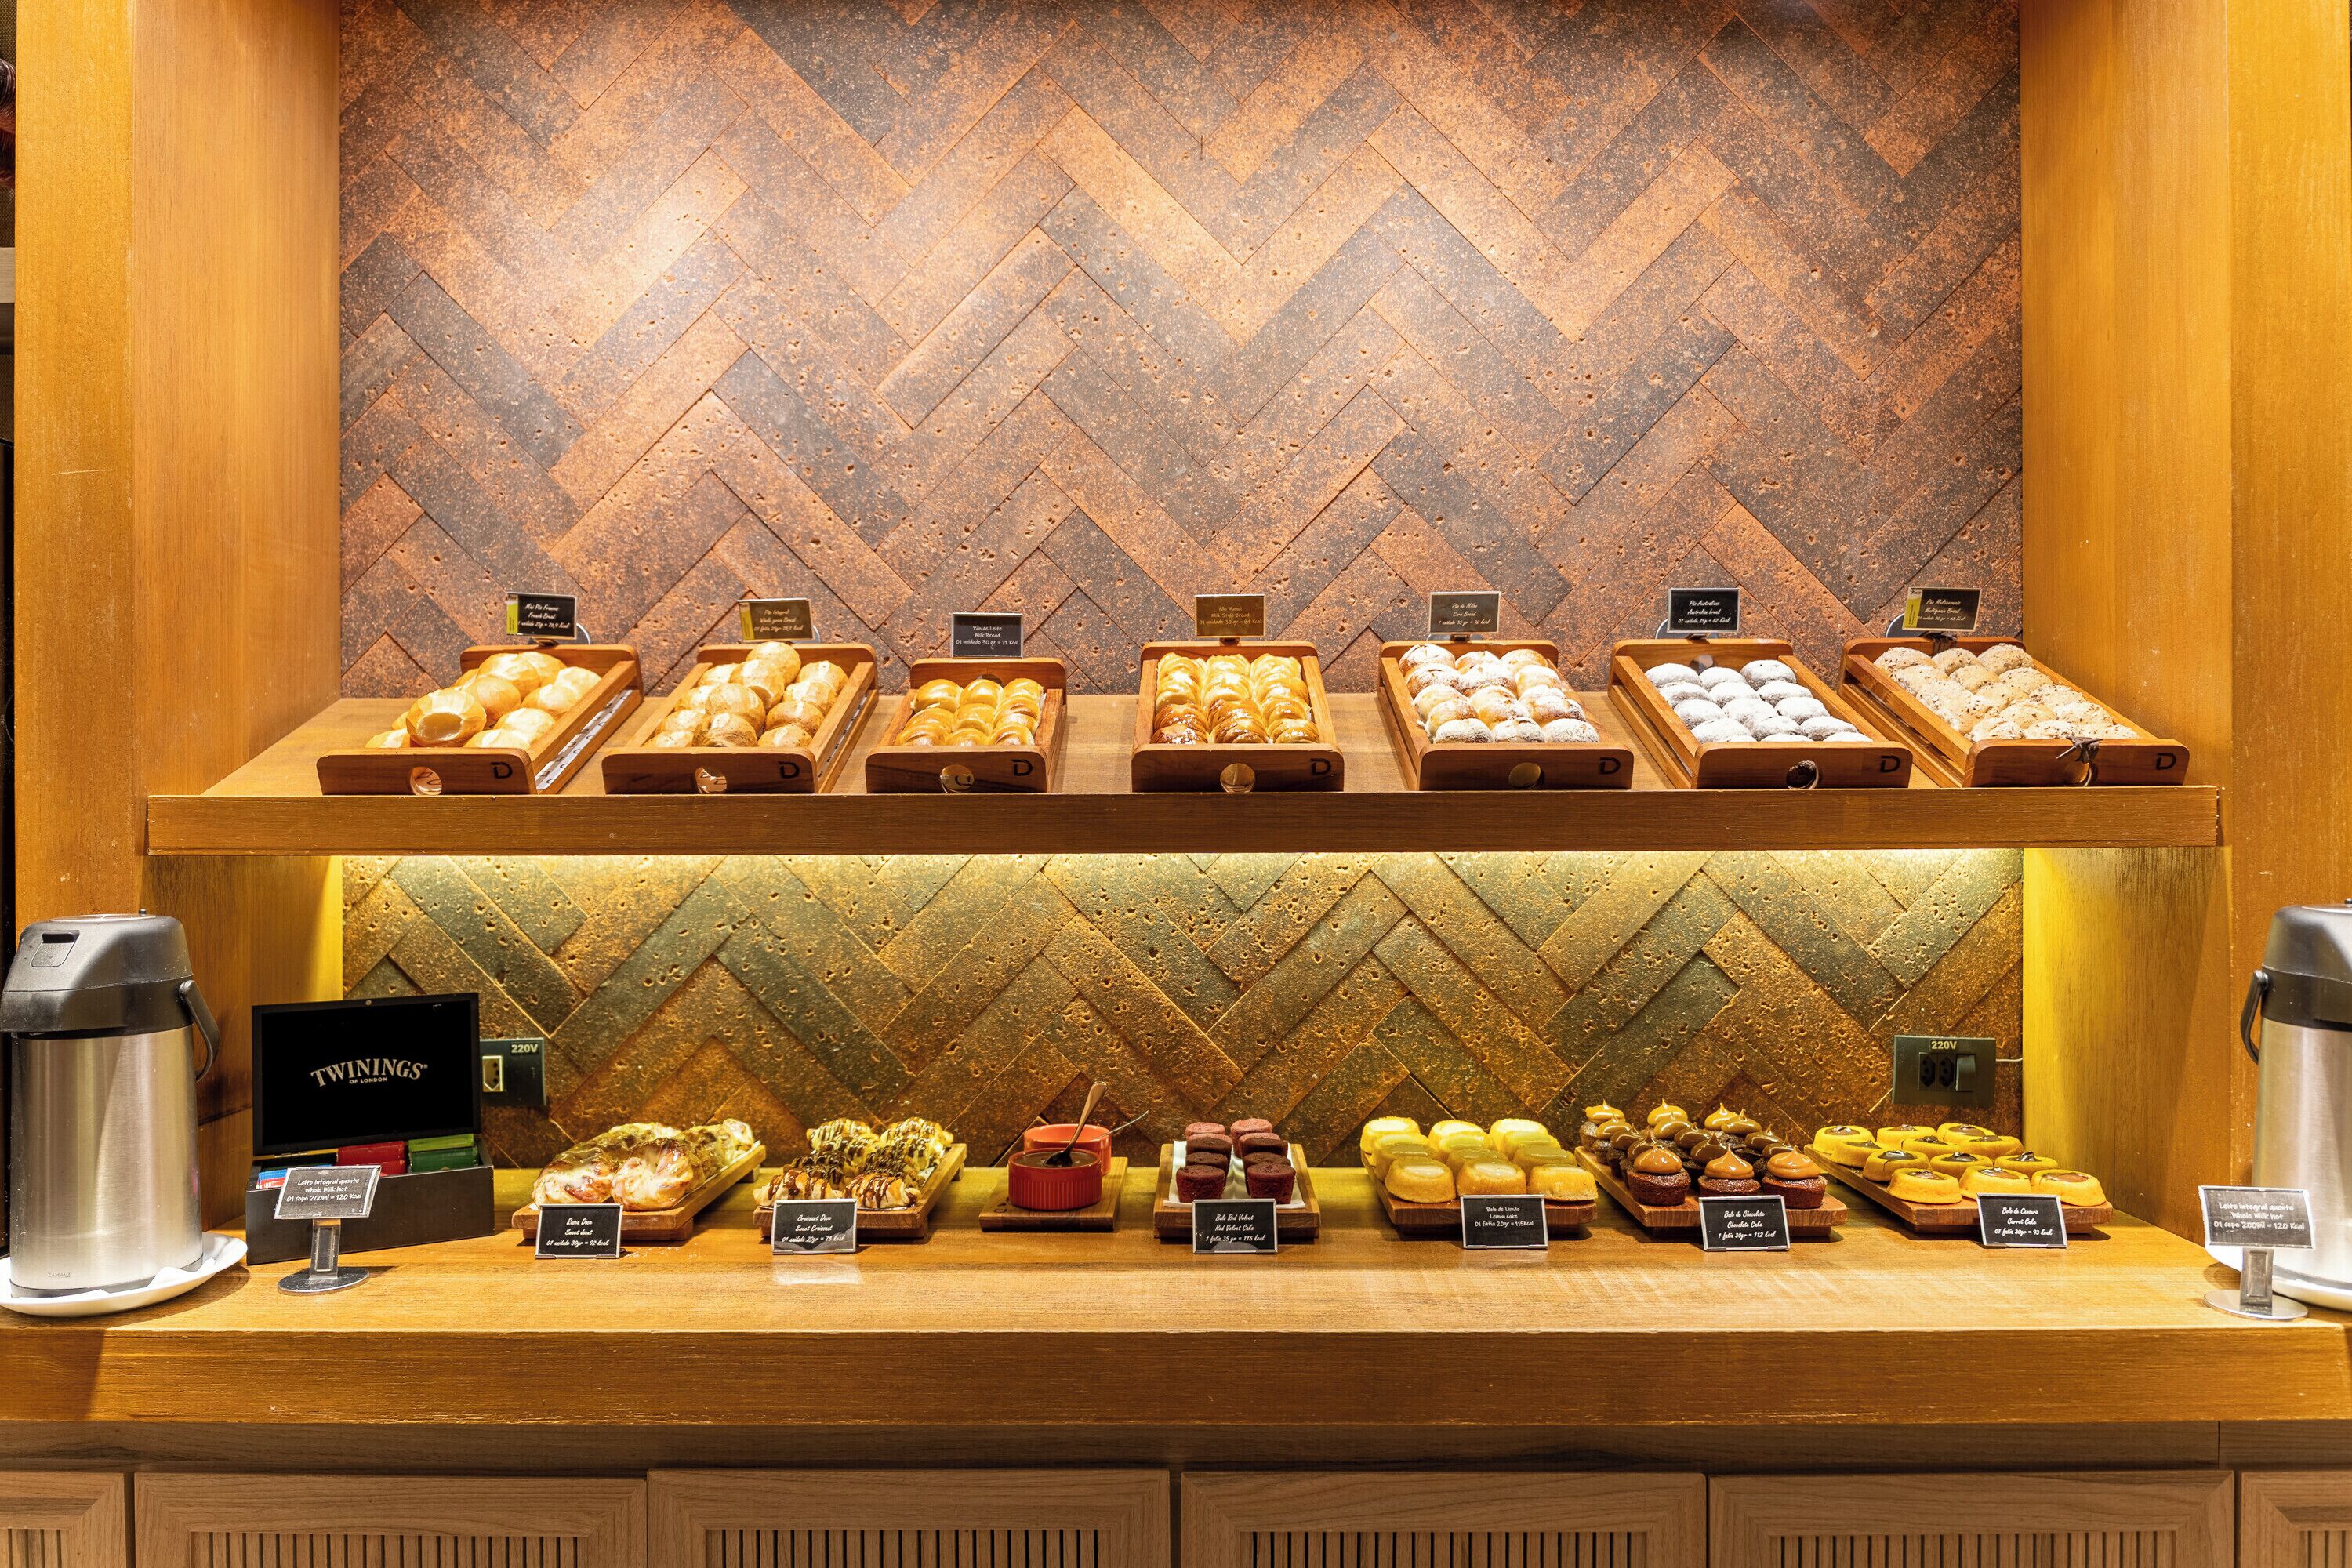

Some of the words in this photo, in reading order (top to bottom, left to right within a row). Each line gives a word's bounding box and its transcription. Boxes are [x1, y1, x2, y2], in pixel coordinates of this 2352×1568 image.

[491, 762, 513, 779] D
[778, 760, 800, 779] D
[1011, 759, 1033, 776] D
[1310, 758, 1332, 776] D
[1599, 757, 1621, 775] D
[1880, 755, 1901, 773] D
[2156, 753, 2177, 771] D
[511, 1044, 538, 1053] 220V
[1931, 1040, 1958, 1050] 220V
[310, 1058, 423, 1087] TWININGS
[2239, 1203, 2267, 1212] integral
[1210, 1235, 1221, 1243] fatia
[1722, 1232, 1733, 1240] fatia
[2002, 1228, 2014, 1236] fatia
